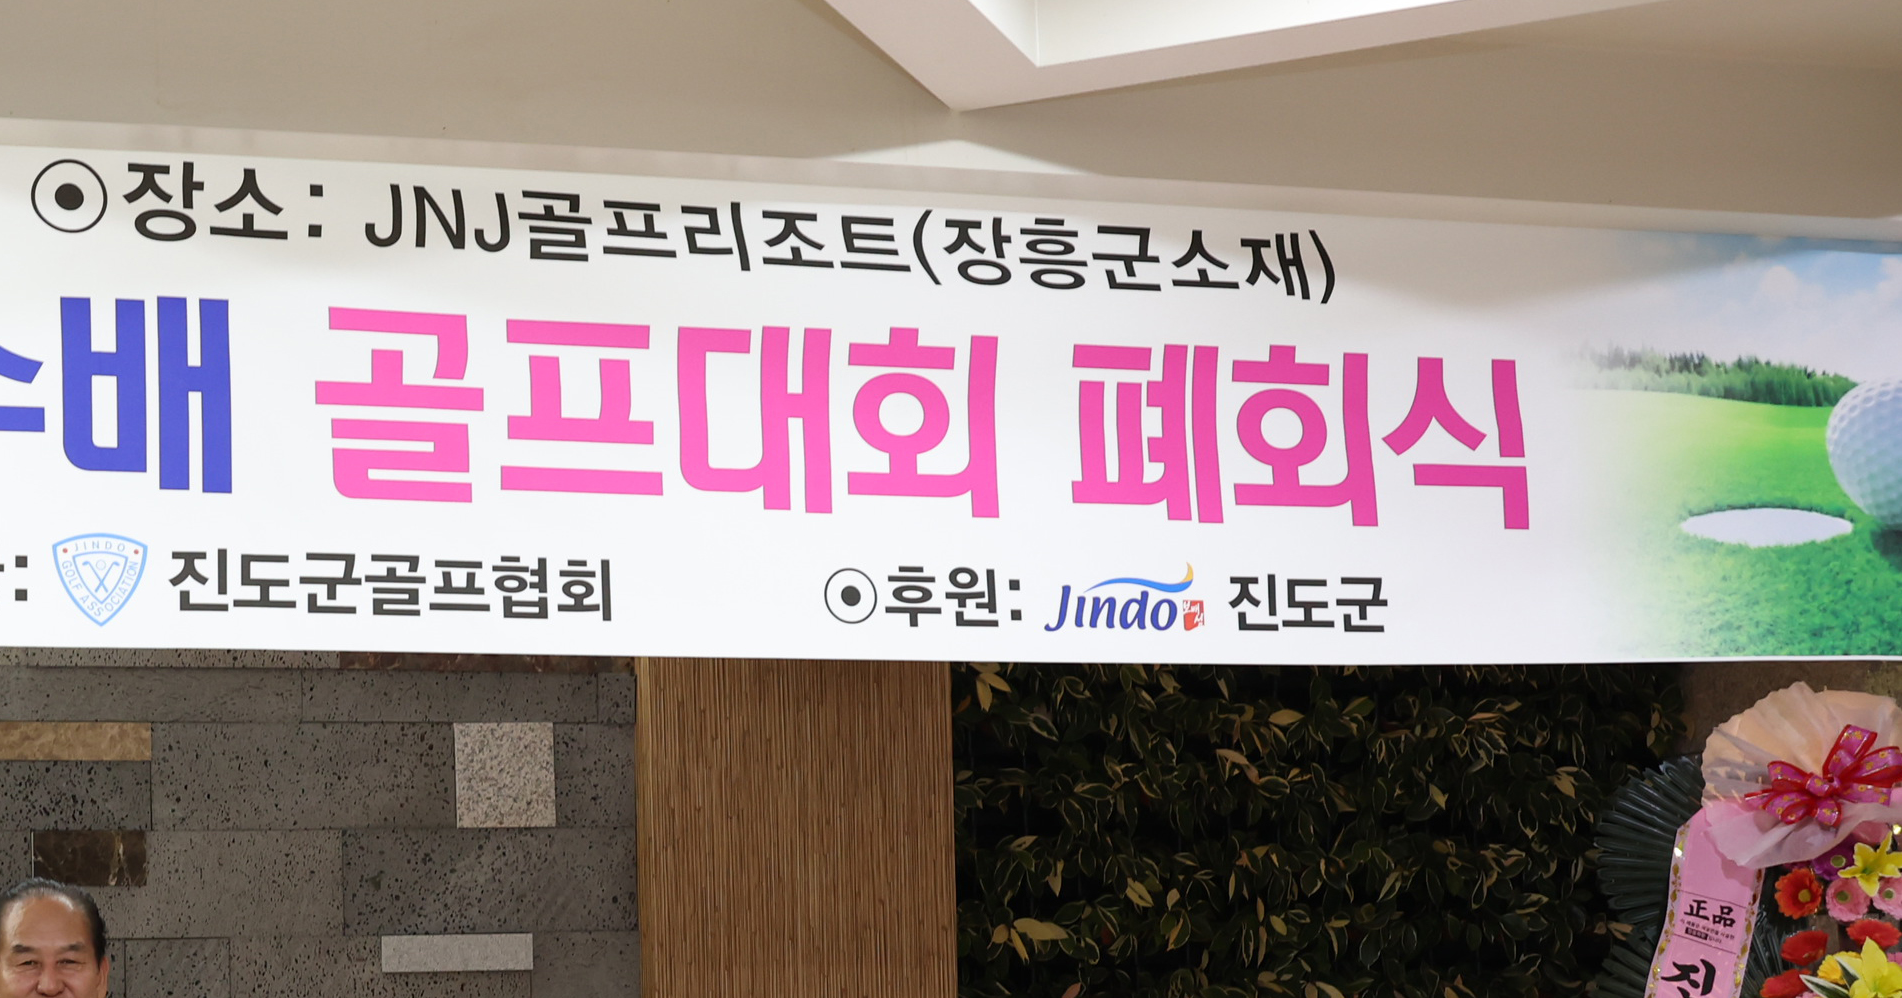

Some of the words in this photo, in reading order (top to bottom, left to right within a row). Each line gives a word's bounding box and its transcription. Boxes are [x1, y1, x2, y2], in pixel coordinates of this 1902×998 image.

[123, 160, 324, 243] 장소:
[364, 182, 1338, 306] JNJ골프리조트(장흥군소재)
[314, 305, 1000, 519] 골프대회
[1071, 342, 1531, 530] 폐회식
[61, 560, 83, 591] GOLF
[74, 540, 126, 553] JINDO
[168, 547, 613, 623] 진도군골프협회
[885, 565, 1022, 627] 후원:
[1044, 583, 1178, 632] Jindo
[1228, 573, 1389, 633] 진도군
[1683, 899, 1736, 928] 正品
